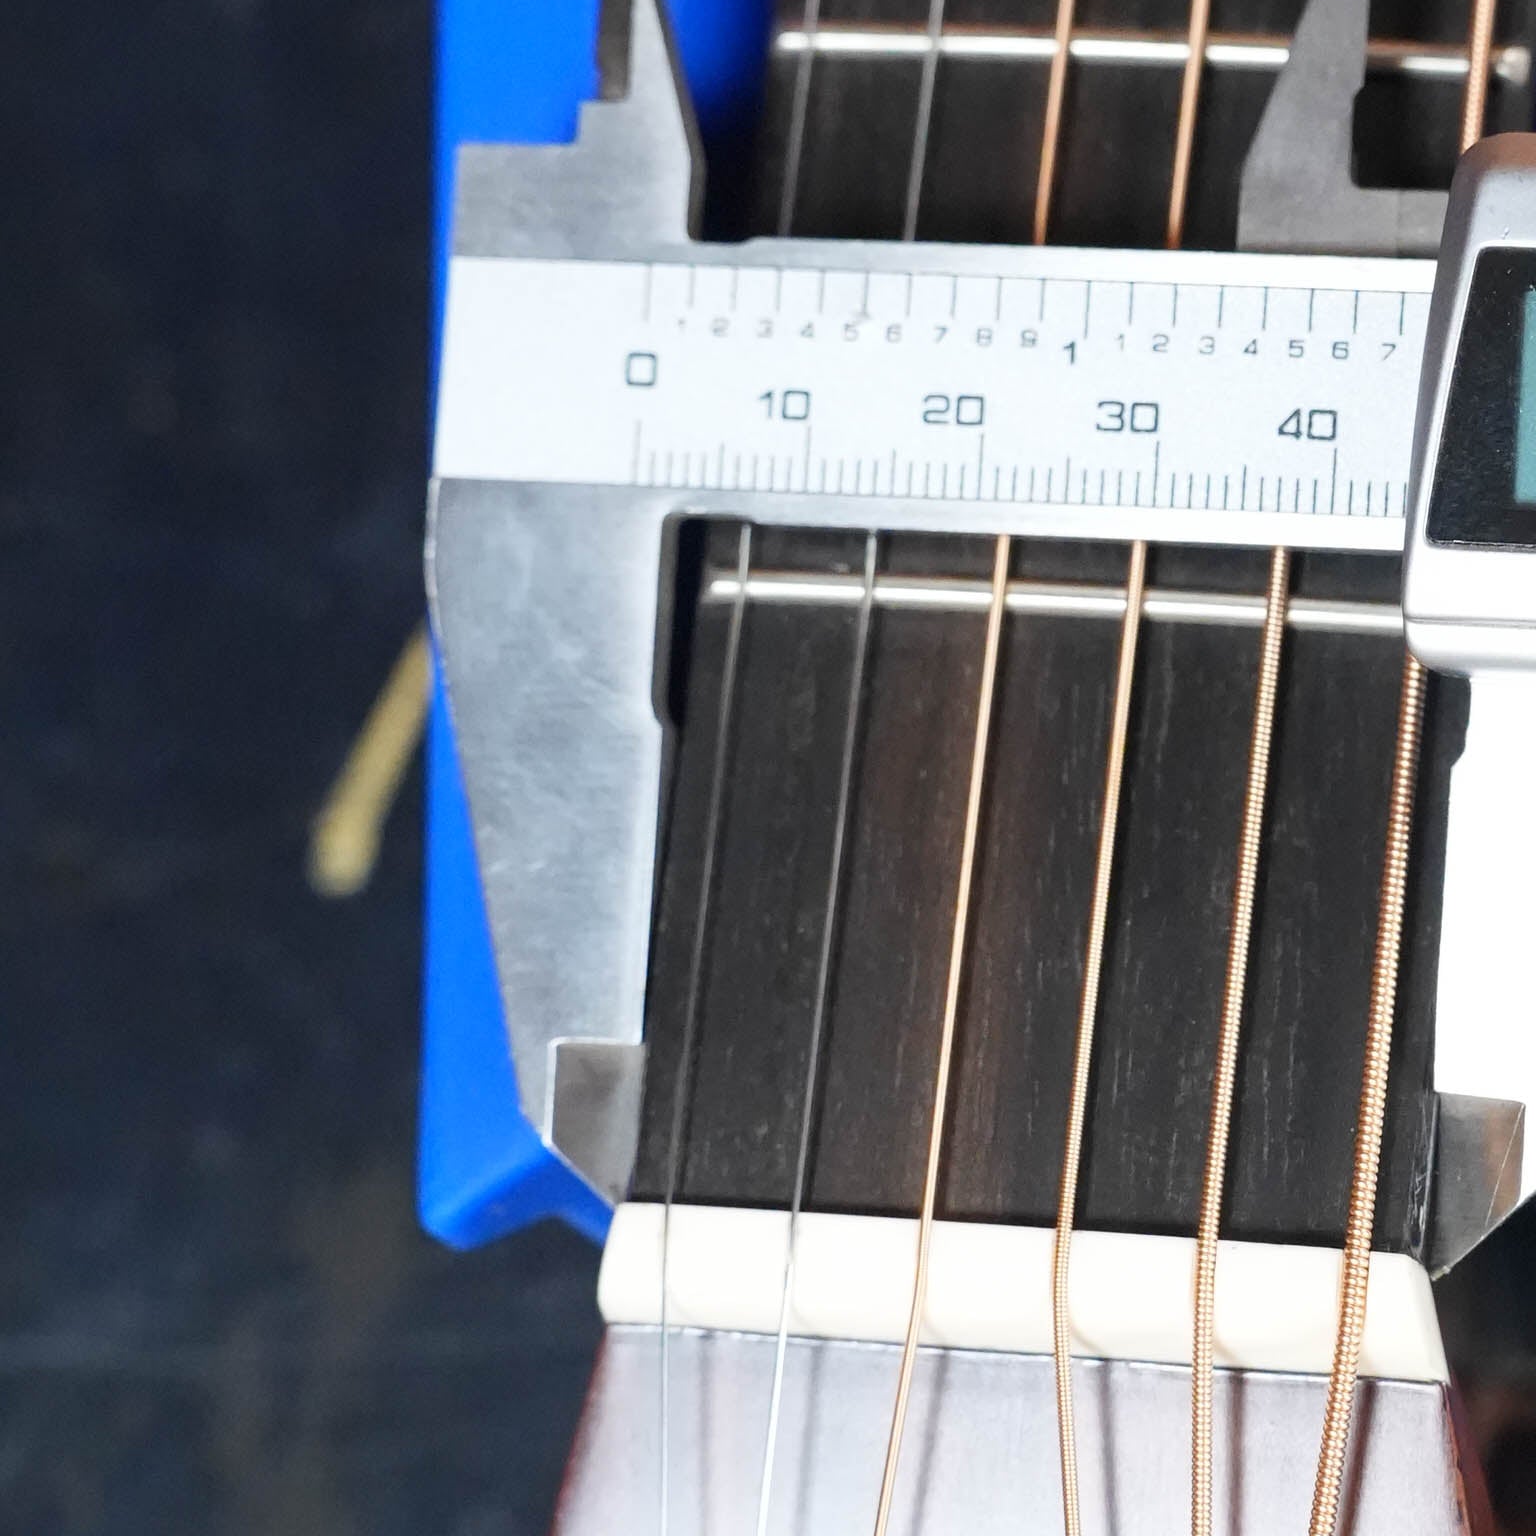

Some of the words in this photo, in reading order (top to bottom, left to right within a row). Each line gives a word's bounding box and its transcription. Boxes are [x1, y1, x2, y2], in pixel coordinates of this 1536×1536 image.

[711, 317, 729, 338] 2
[756, 318, 774, 339] 3
[799, 321, 815, 339] 4
[843, 321, 860, 343] 5
[885, 323, 902, 343] 6
[934, 325, 949, 343] 7
[975, 327, 993, 347] 8
[1020, 329, 1038, 348] 9
[1063, 341, 1076, 364] 1
[1116, 333, 1125, 351] 1
[1151, 333, 1170, 353] 2
[1198, 335, 1216, 356] 3
[1243, 338, 1258, 355] 4
[1288, 339, 1305, 359] 5
[1331, 341, 1349, 360] 6
[1381, 342, 1397, 361] 7
[625, 351, 658, 388] 0
[759, 389, 811, 421] 10
[922, 394, 985, 426] 20
[1096, 400, 1160, 434] 30
[1277, 408, 1338, 442] 40
